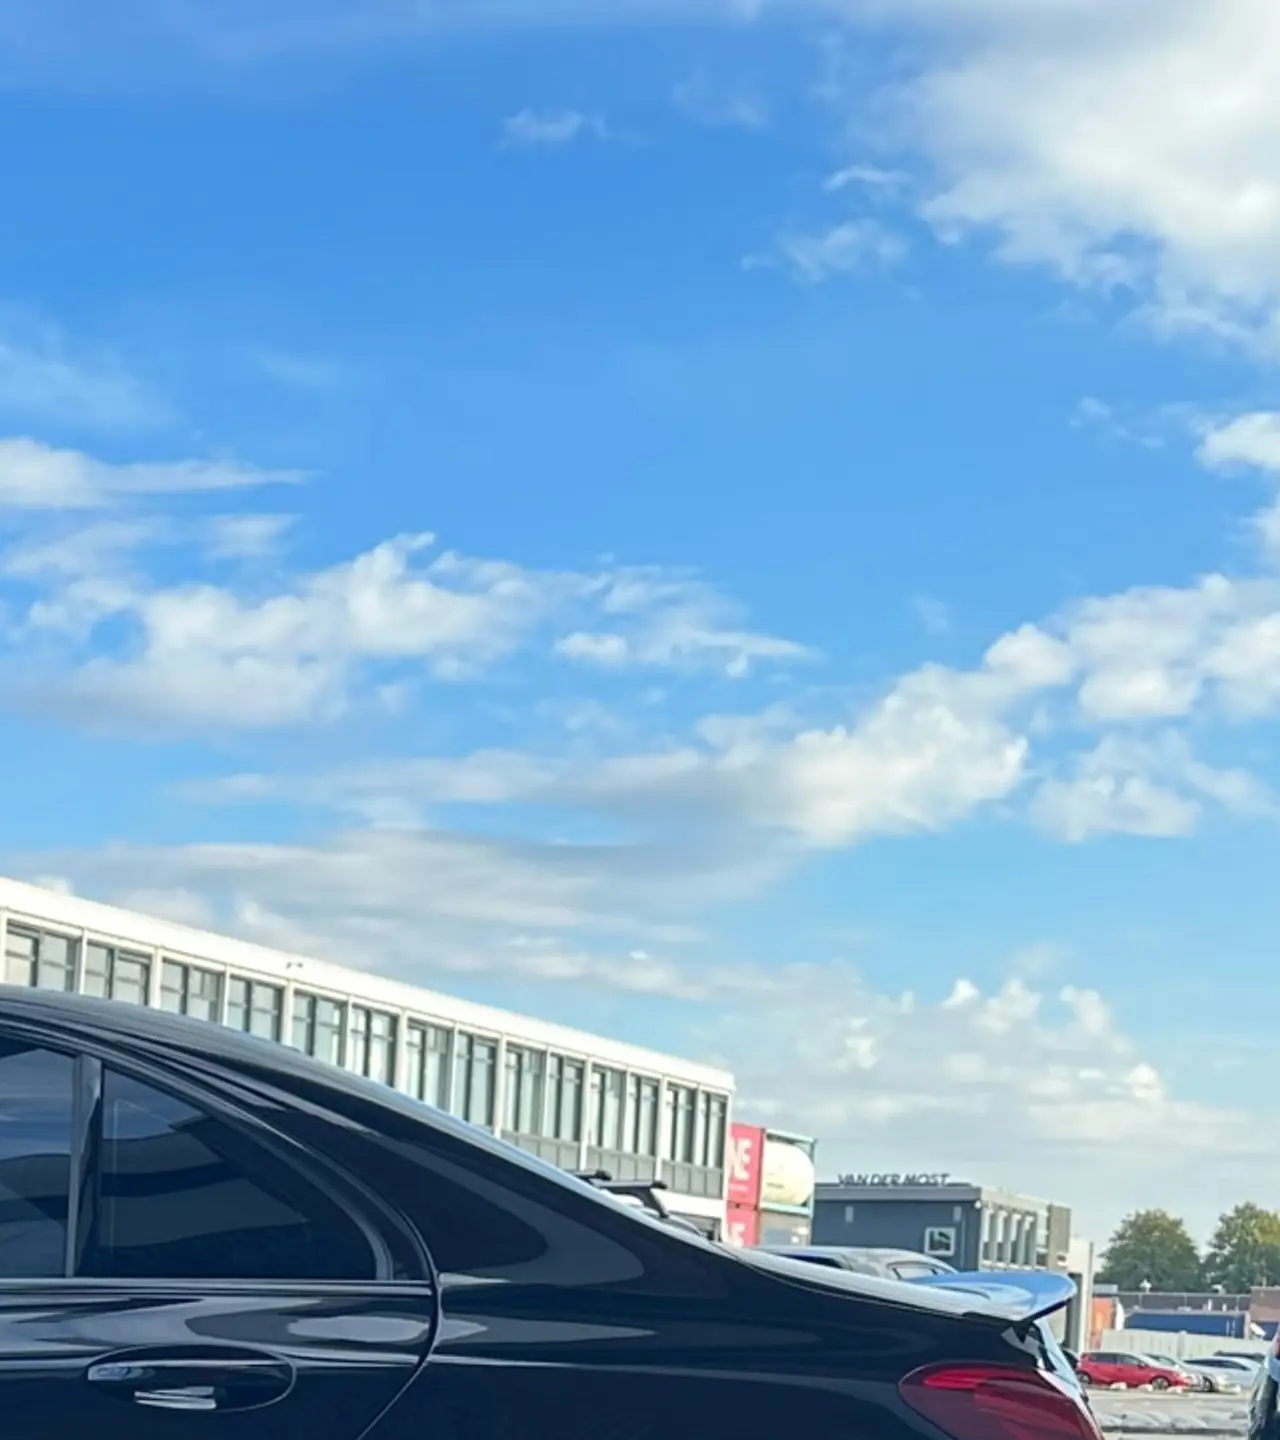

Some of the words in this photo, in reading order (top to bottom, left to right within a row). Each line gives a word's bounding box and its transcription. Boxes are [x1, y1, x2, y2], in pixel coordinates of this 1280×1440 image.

[838, 1173, 870, 1187] VAN
[871, 1173, 901, 1187] DER
[905, 1173, 950, 1187] MOST
